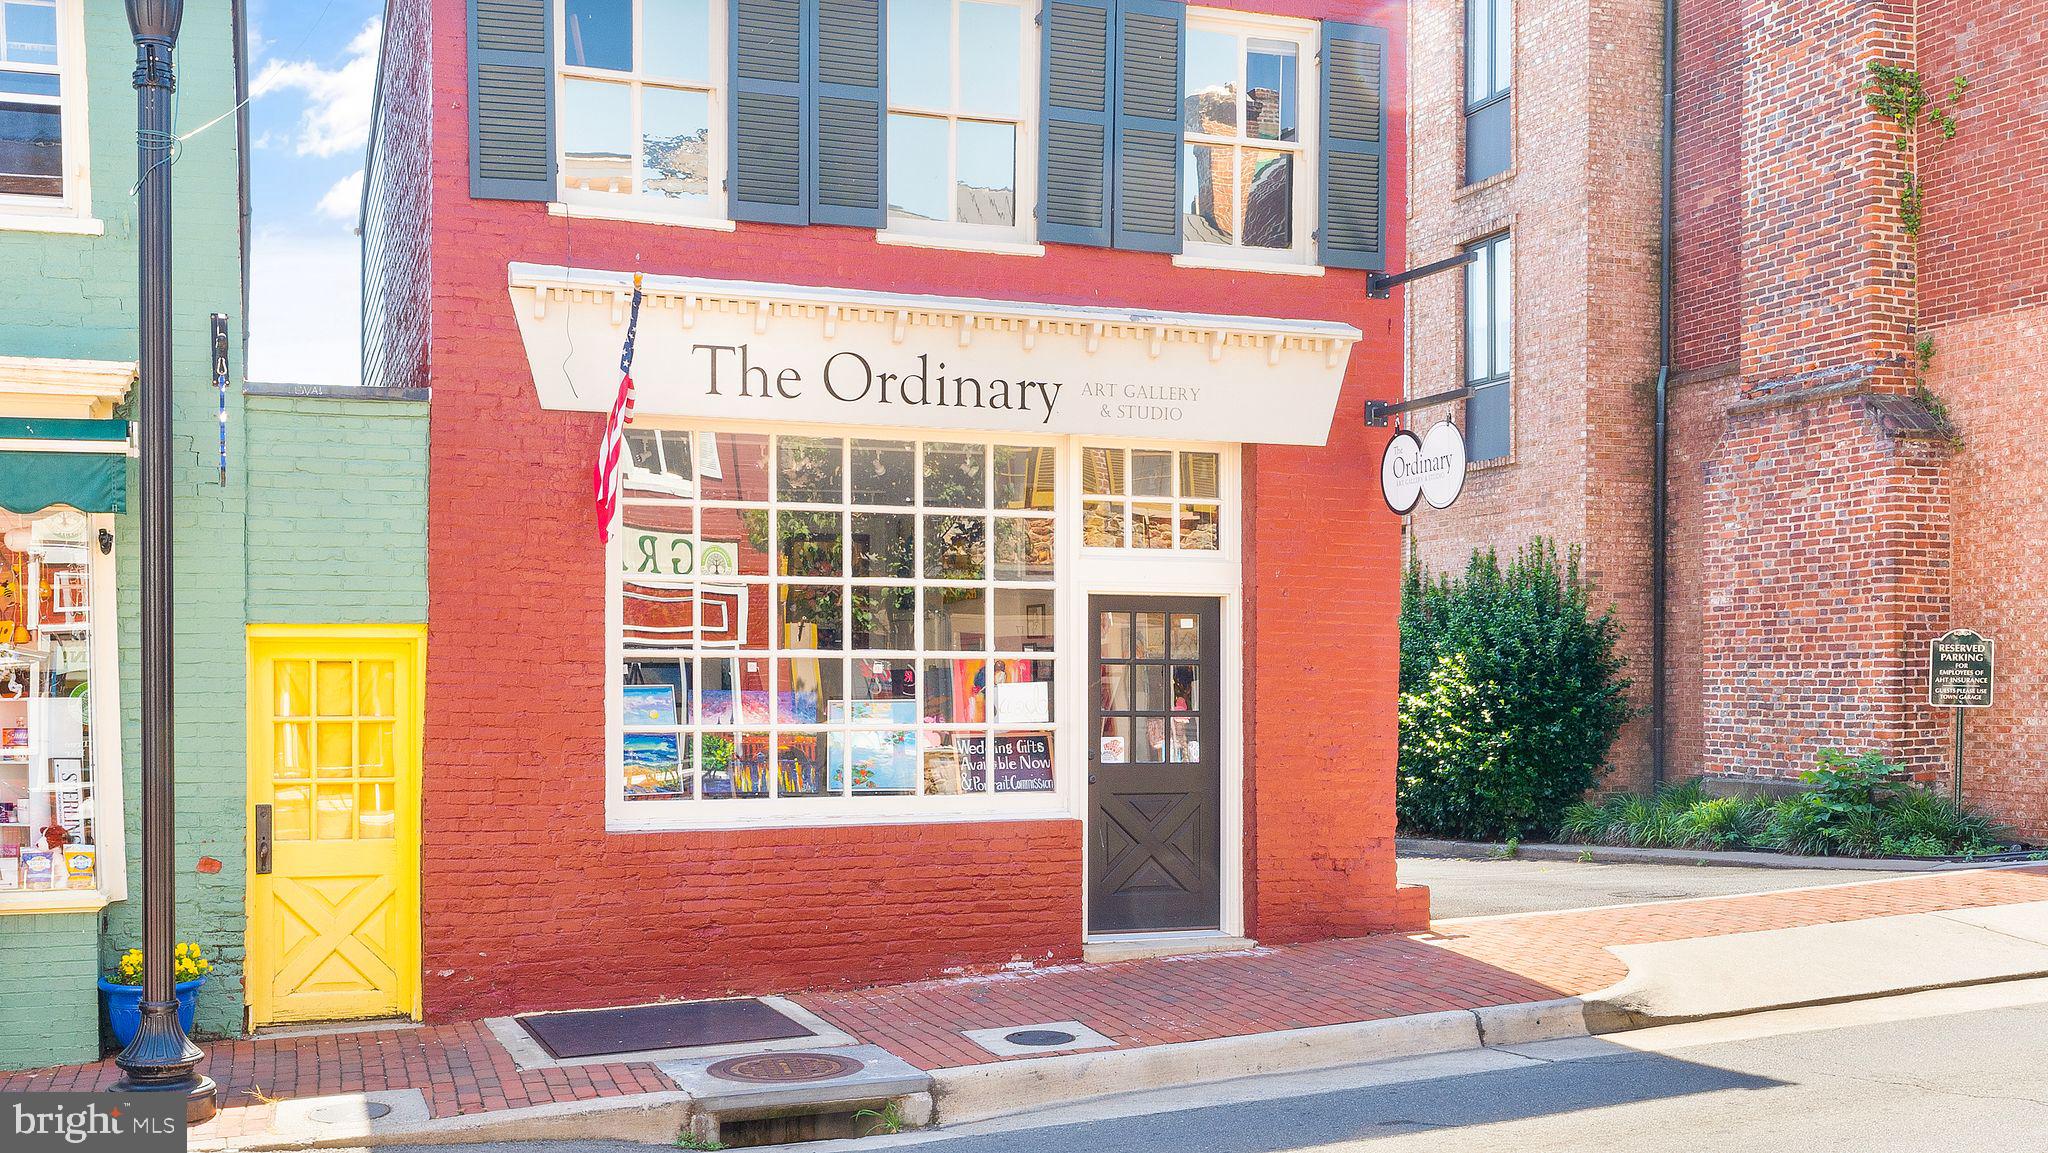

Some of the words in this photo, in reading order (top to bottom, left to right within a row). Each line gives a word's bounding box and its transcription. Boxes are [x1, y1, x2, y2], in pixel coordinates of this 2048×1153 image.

[692, 343, 801, 399] The
[823, 351, 1063, 424] Ordinary
[1081, 382, 1117, 397] ART
[1124, 384, 1200, 401] GALLERY
[1100, 403, 1111, 418] &
[1117, 404, 1183, 421] STUDIO
[1393, 446, 1403, 455] The
[1393, 452, 1452, 478] Ordinary
[1939, 644, 1985, 652] RESERVED
[1940, 653, 1984, 662] PARKING
[957, 739, 1013, 755] Weding
[1016, 739, 1045, 754] Gifts
[961, 756, 1017, 770] Avaible
[1020, 755, 1051, 769] Now
[961, 773, 973, 790] &
[973, 775, 1010, 791] Poait
[1010, 774, 1054, 790] Commission
[62, 773, 81, 844] SERLIN
